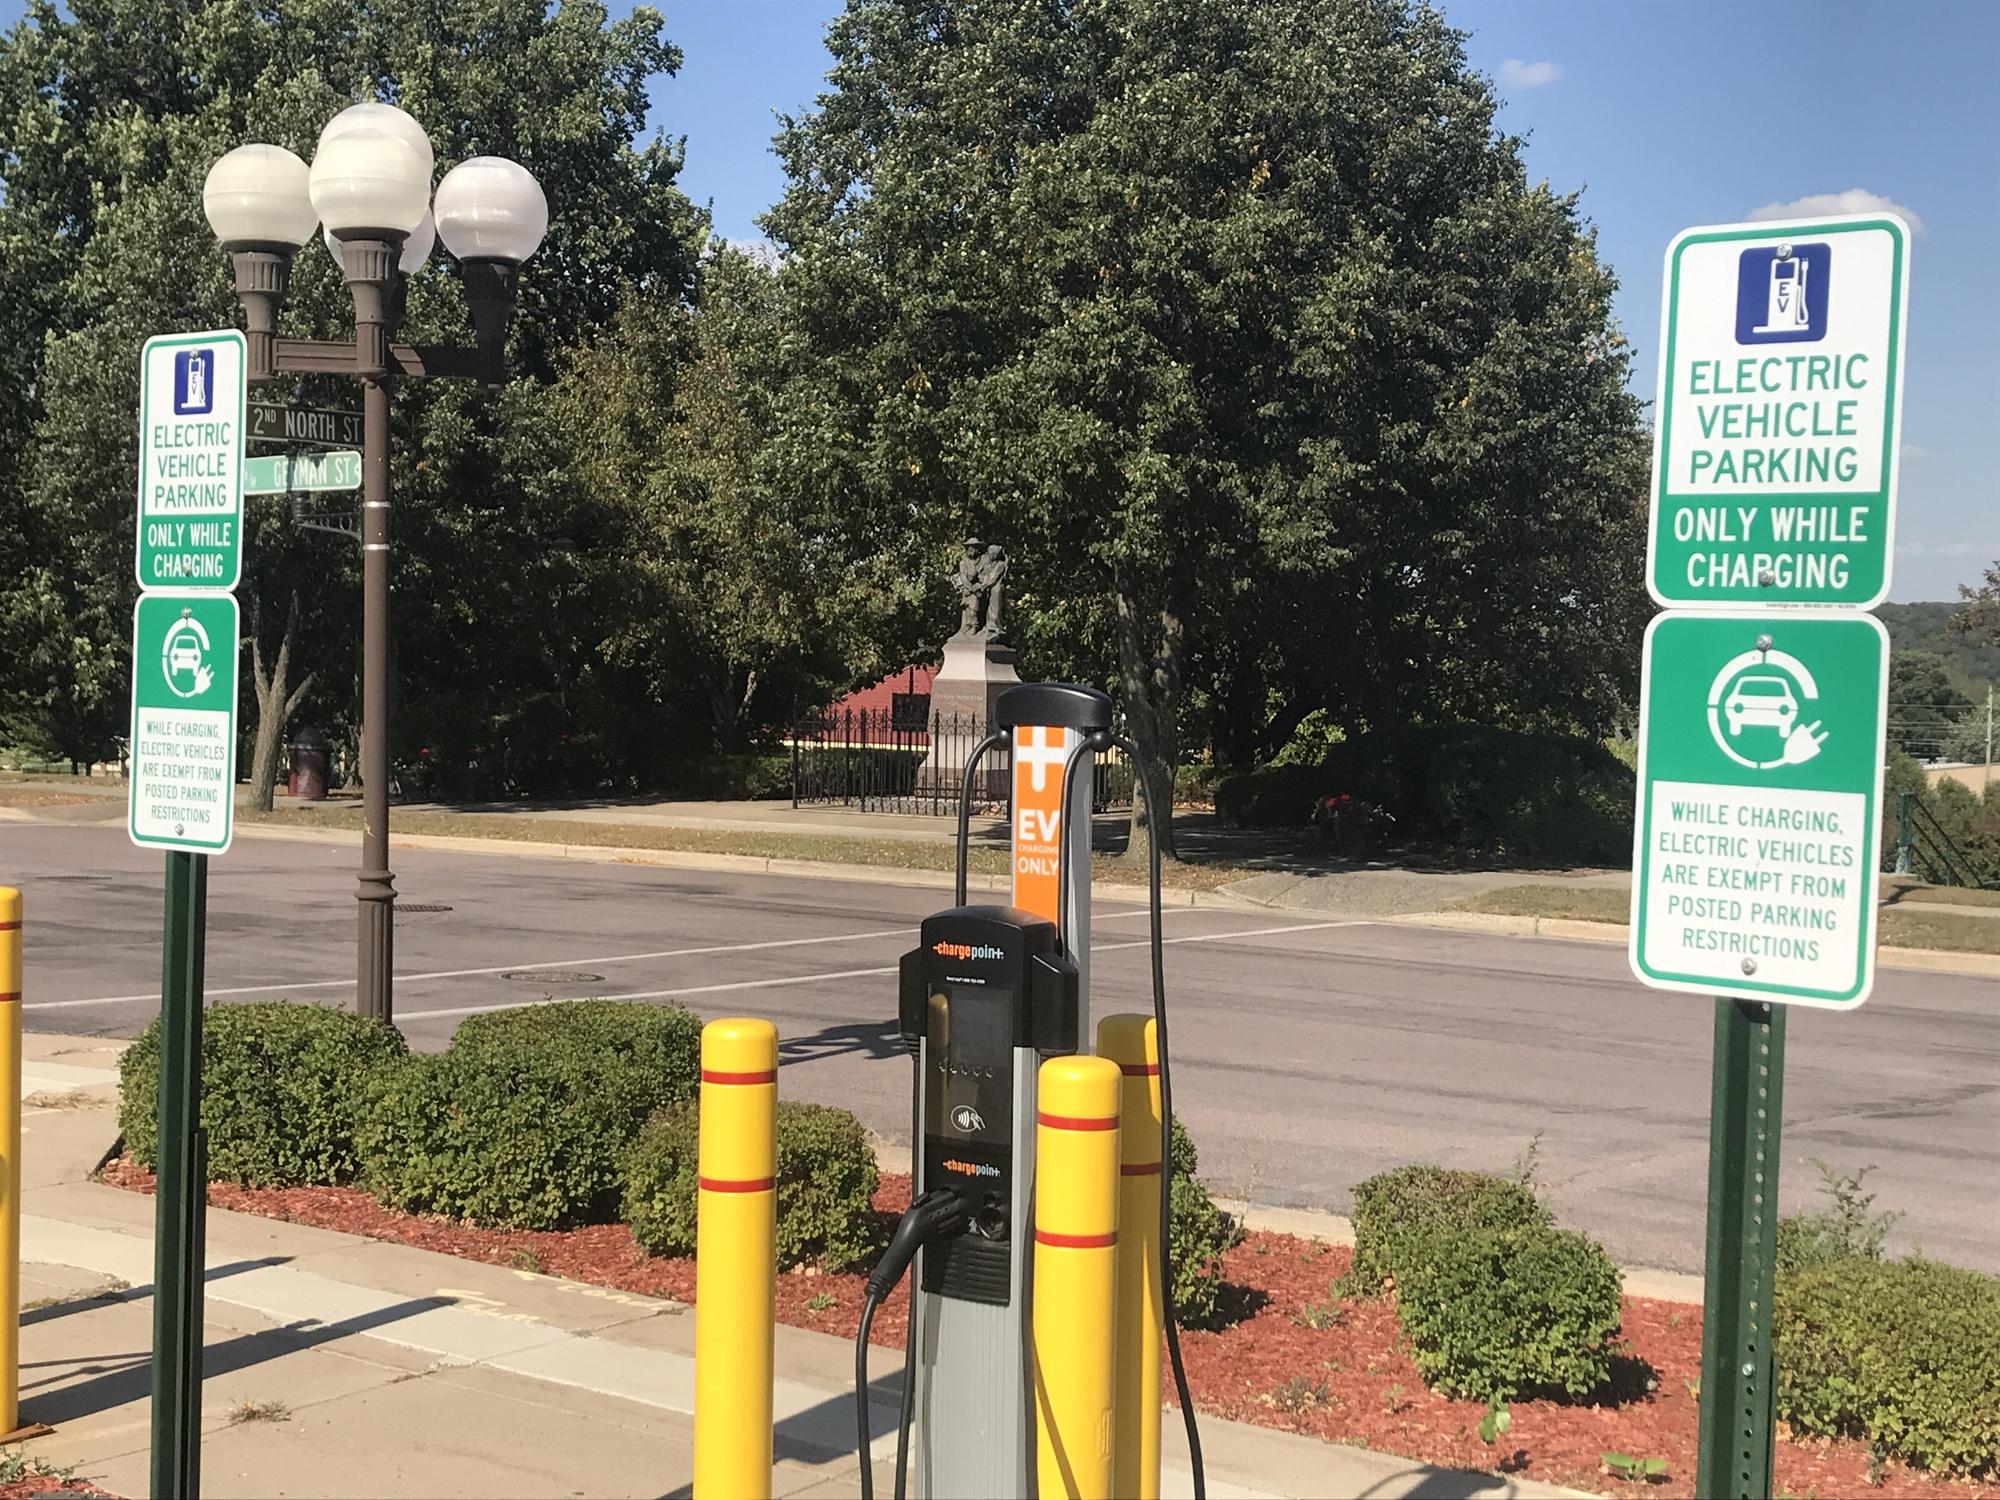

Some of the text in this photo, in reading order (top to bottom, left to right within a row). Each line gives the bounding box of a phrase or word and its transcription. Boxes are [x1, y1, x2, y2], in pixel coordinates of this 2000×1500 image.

[1777, 281, 1791, 313] EV
[1690, 353, 1869, 395] ELECTRIC
[154, 422, 231, 448] ELECTRIC
[285, 410, 336, 441] NORTH
[343, 416, 361, 442] ST
[1697, 400, 1858, 439] VEHICLE
[157, 453, 226, 478] VEHICLE
[335, 457, 351, 484] ST
[1690, 446, 1858, 485] PARKING
[154, 483, 227, 508] PARKING
[148, 522, 232, 547] ONLY WHILE
[1674, 507, 1869, 542] ONLY WHILE
[153, 553, 224, 578] CHARGING
[1686, 553, 1849, 588] CHARGING
[146, 720, 221, 740] WHILE CHARGING,
[141, 740, 225, 761] ELECTRIC VEHICLES
[142, 761, 222, 782] ARE EXEMPT FROM
[145, 783, 218, 803] POSTED PARKING
[151, 804, 210, 824] RESTRICTIONS
[1019, 808, 1061, 842] EV
[1671, 801, 1843, 835] WHILE CHARGING,
[1659, 831, 1854, 867] ELECTRIC VEHICLES
[1018, 856, 1059, 876] ONLY
[1662, 864, 1846, 899] ARE EXEMPT FROM
[1668, 895, 1837, 931] POSTED PARKING
[1682, 928, 1819, 961] RESTRICTIONS
